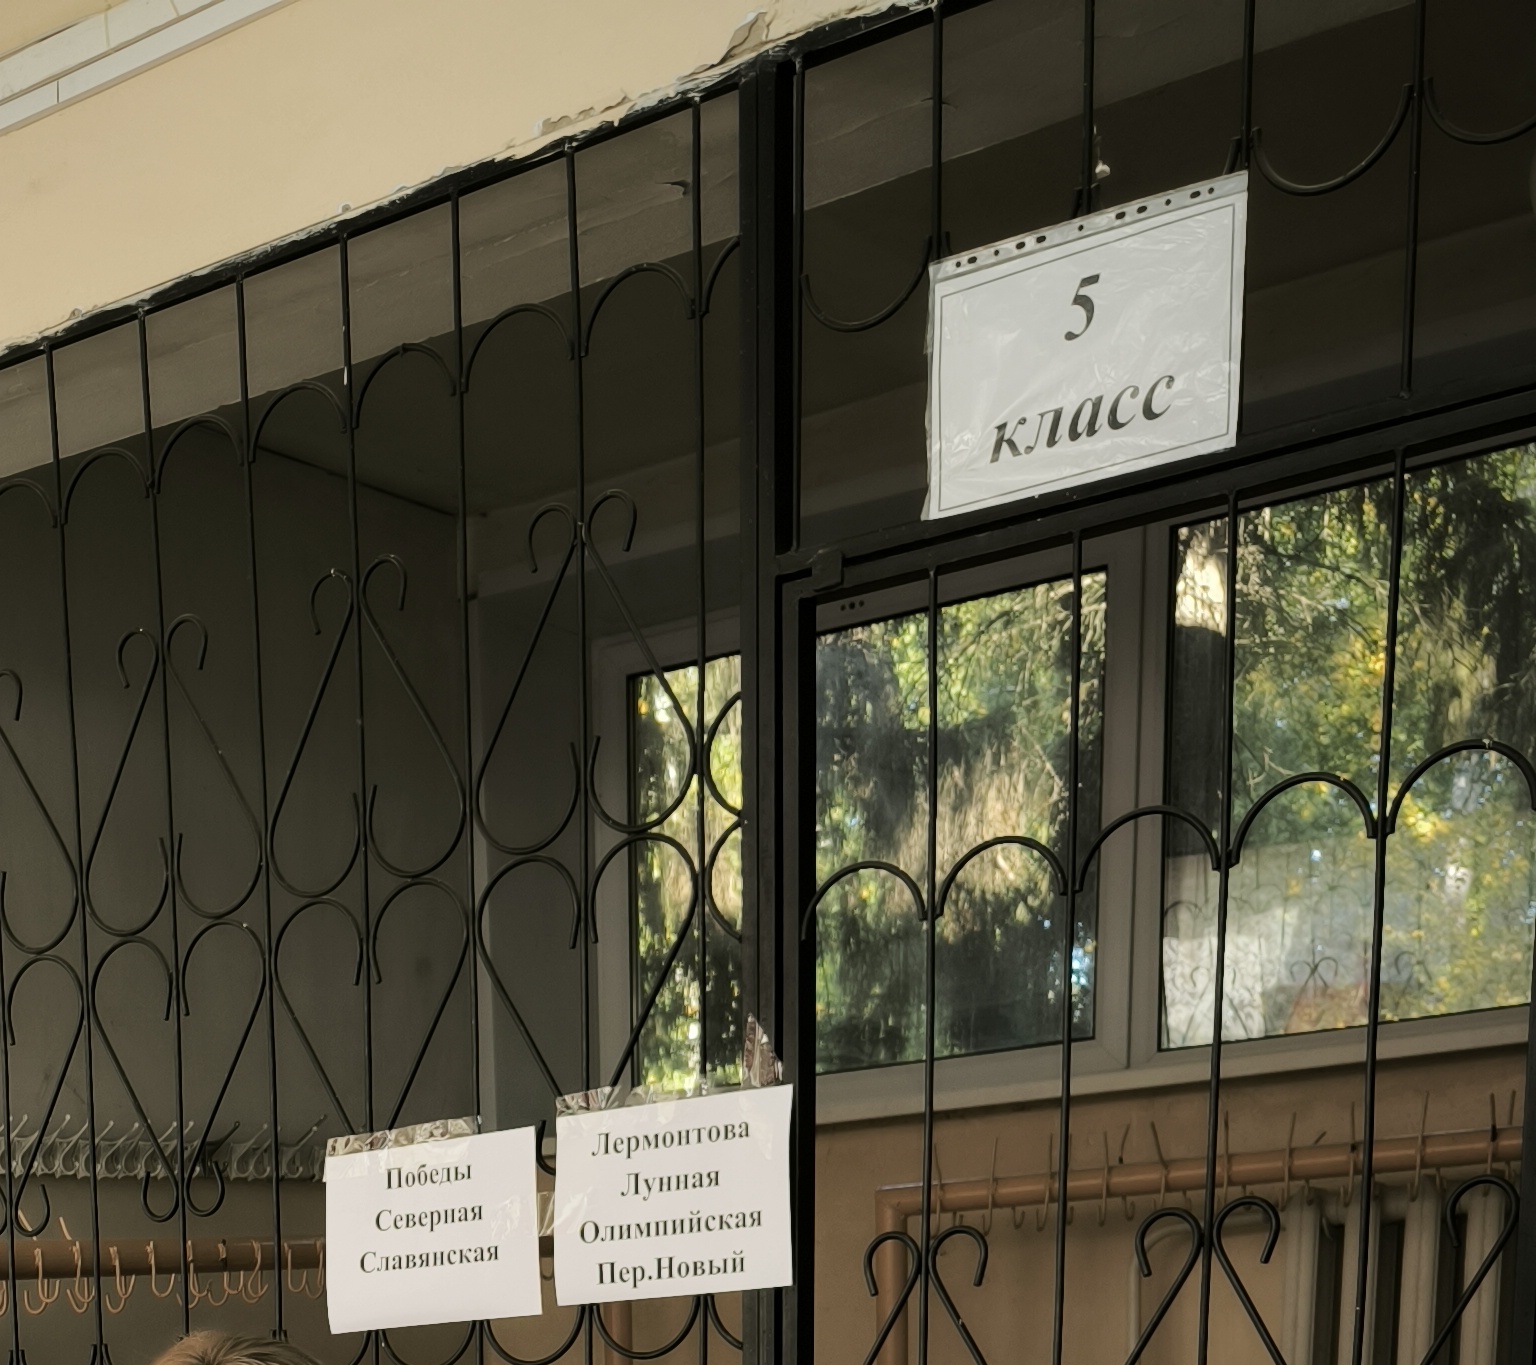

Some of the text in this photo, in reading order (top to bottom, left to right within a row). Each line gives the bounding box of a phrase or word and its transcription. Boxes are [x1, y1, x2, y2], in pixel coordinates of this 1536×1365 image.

[1063, 273, 1101, 341] 5
[989, 375, 1176, 464] класс
[591, 1120, 751, 1159] Лермонтова
[385, 1164, 472, 1191] Победы
[620, 1170, 721, 1202] Лунная
[375, 1204, 484, 1235] Северная
[579, 1209, 764, 1245] Олимпийская
[359, 1244, 500, 1274] Славянская
[596, 1250, 746, 1288] Пер.Новый
